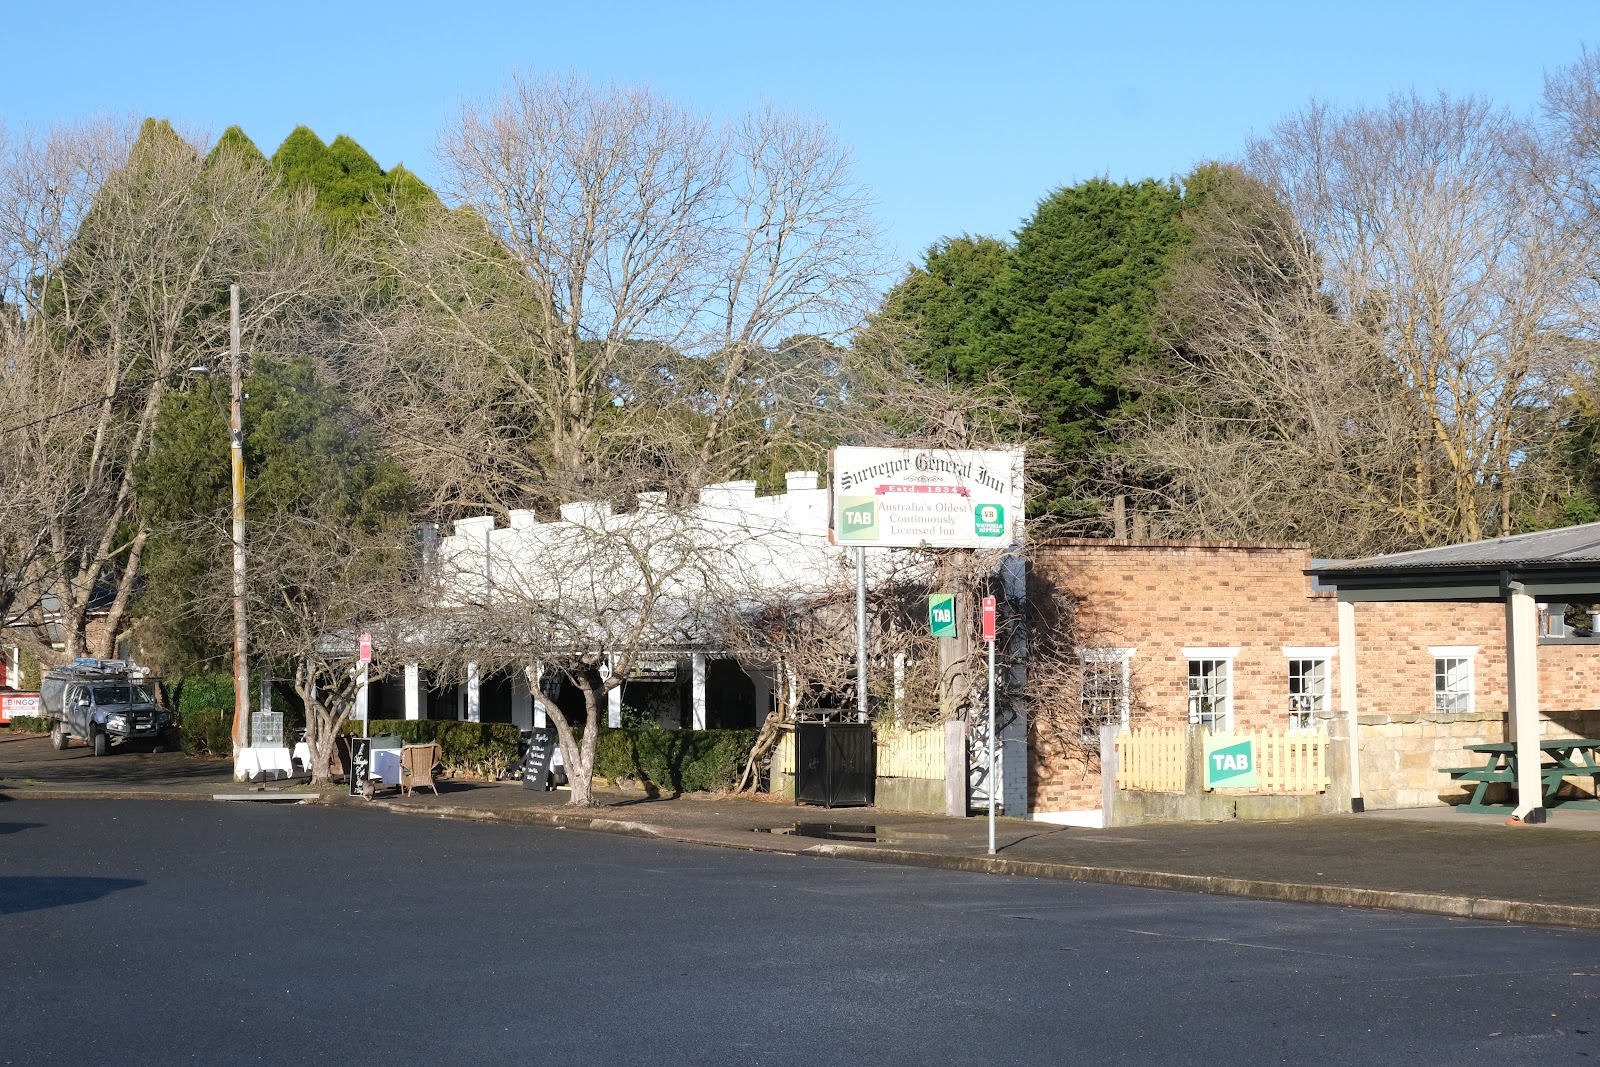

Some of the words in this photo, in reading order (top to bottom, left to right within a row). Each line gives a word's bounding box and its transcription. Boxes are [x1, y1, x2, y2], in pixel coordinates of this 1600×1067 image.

[841, 457, 911, 492] Surveyor
[915, 452, 972, 479] General
[974, 466, 1005, 494] Inn
[888, 485, 920, 493] Estd.
[926, 486, 958, 494] 1834
[878, 501, 932, 513] Australia's
[935, 502, 968, 513] Oldest
[846, 512, 872, 525] TAB
[889, 514, 957, 526] Continuously
[891, 525, 935, 536] Licensed
[938, 526, 955, 537] Inn
[932, 609, 951, 622] TAB
[1212, 754, 1248, 770] TAB
